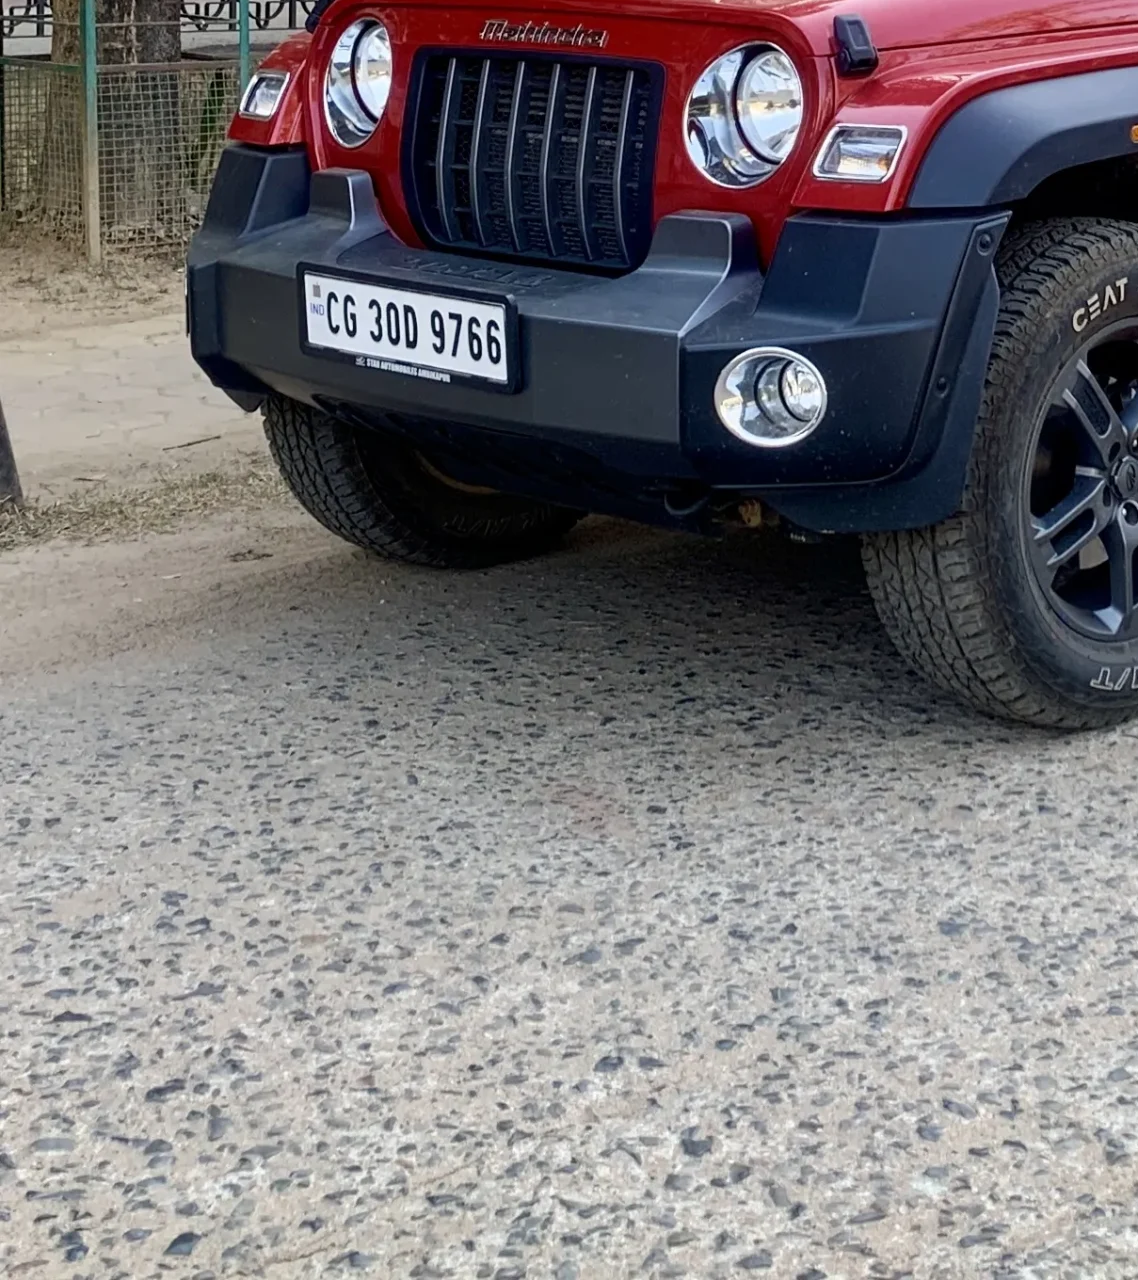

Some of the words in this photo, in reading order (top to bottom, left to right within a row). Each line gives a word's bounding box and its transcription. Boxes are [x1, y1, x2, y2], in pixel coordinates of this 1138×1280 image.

[479, 19, 609, 48] Mahindra
[1071, 276, 1129, 333] CEAT
[309, 302, 325, 316] IND
[326, 291, 357, 338] CG
[369, 298, 418, 349] 30D
[431, 309, 502, 365] 9766
[366, 357, 380, 369] STAR
